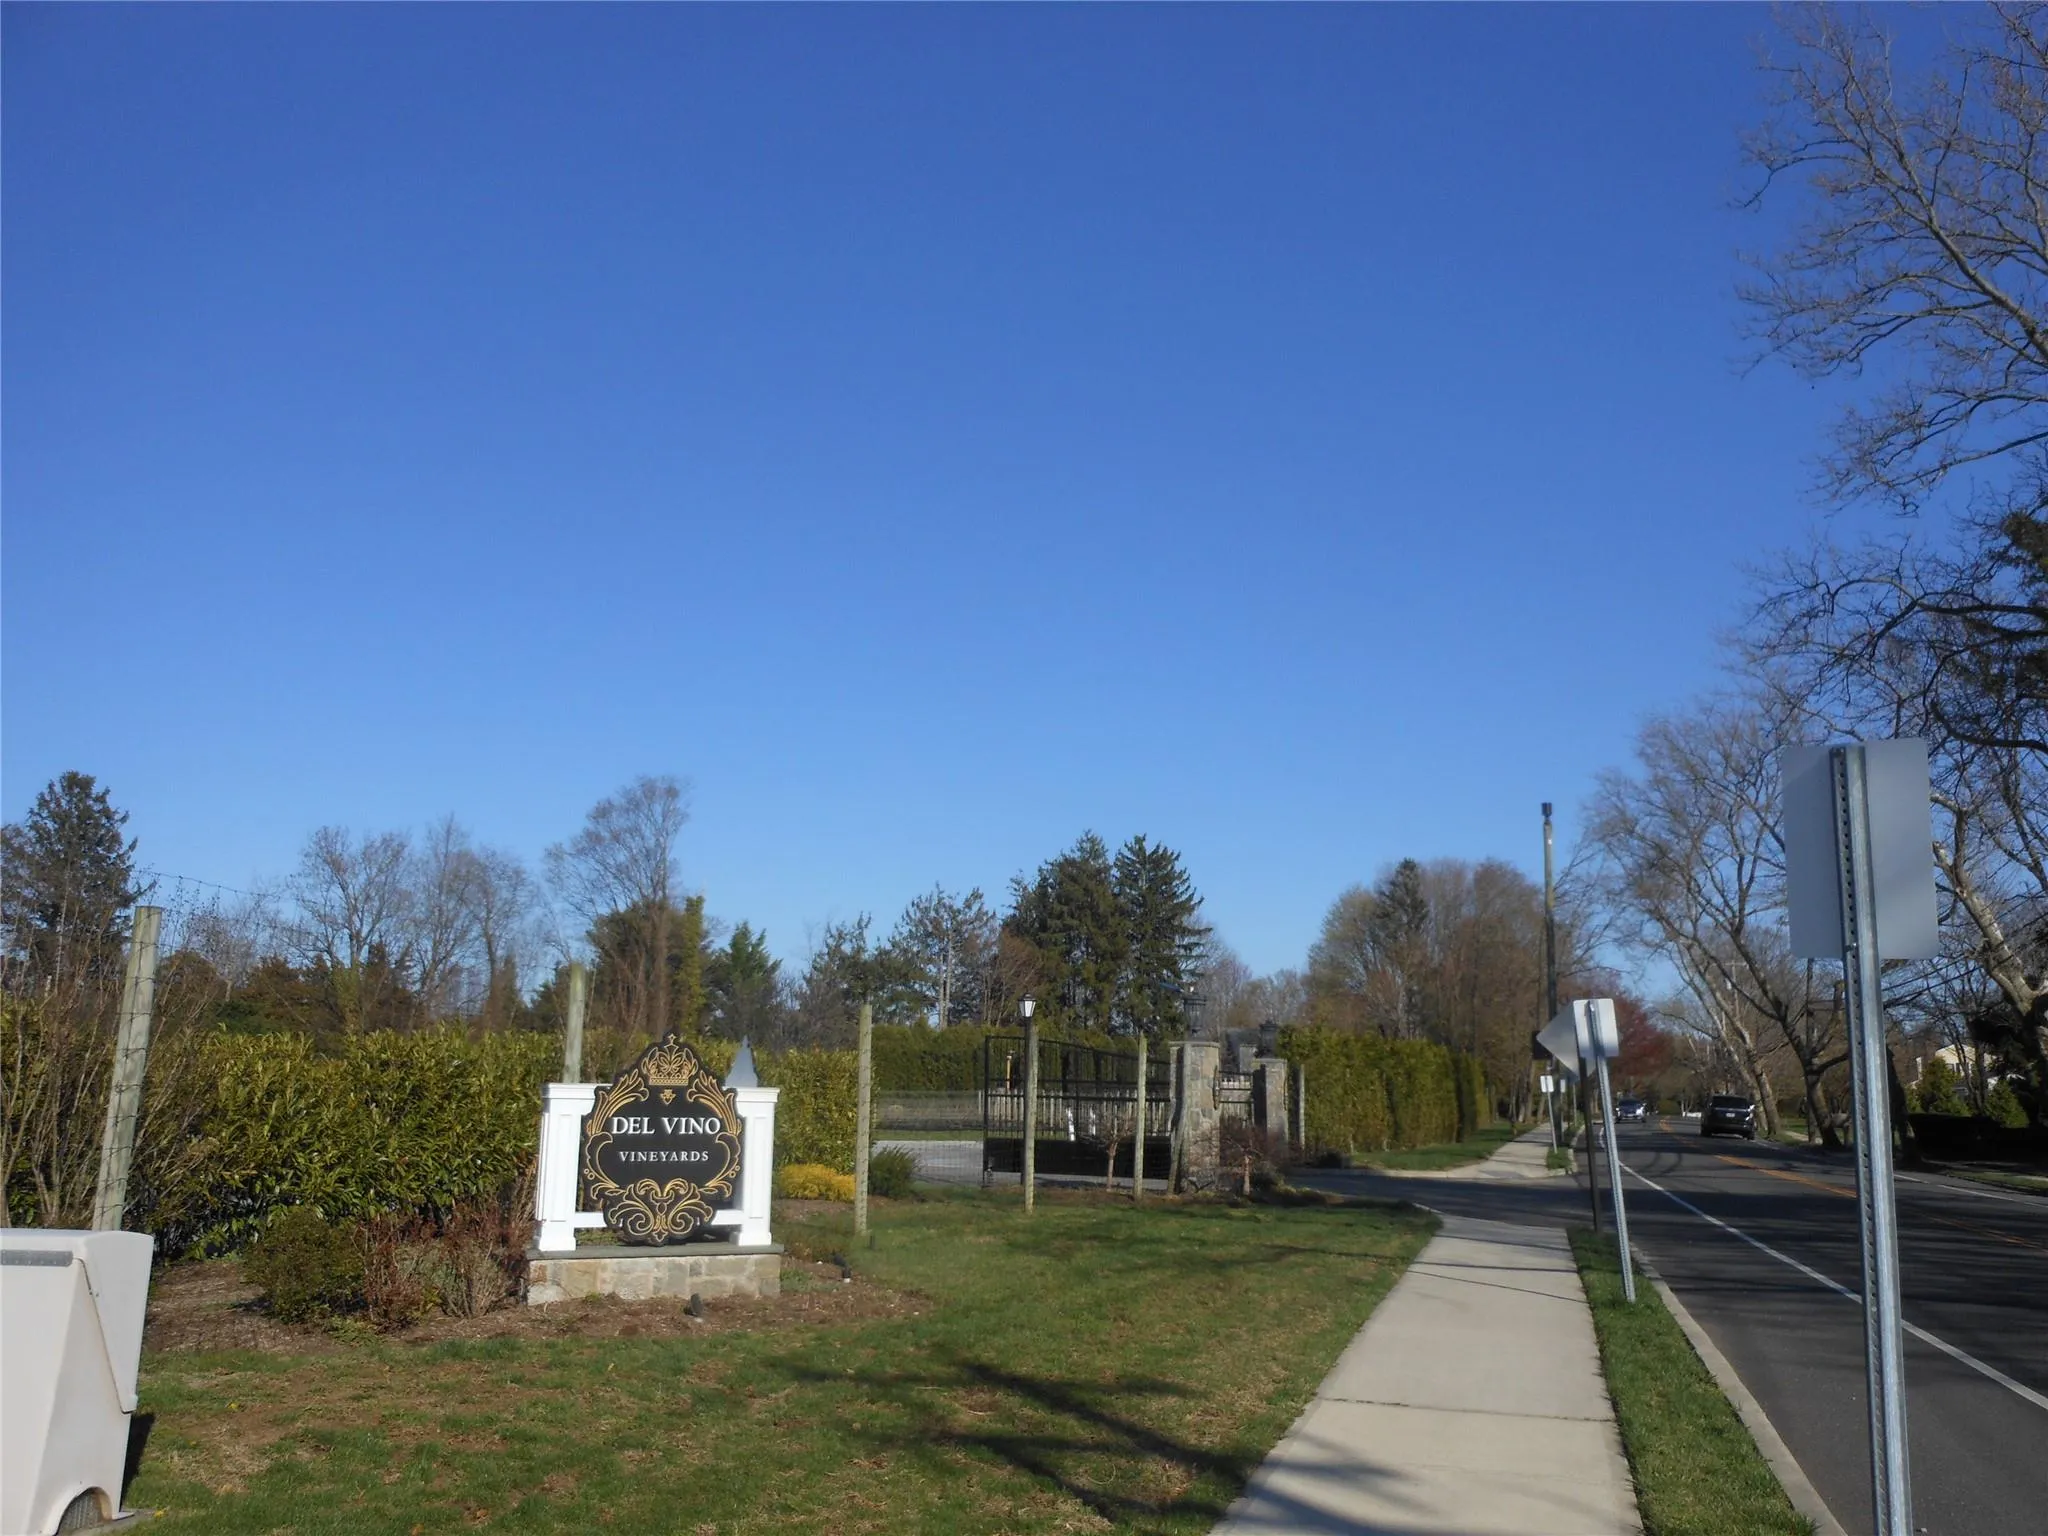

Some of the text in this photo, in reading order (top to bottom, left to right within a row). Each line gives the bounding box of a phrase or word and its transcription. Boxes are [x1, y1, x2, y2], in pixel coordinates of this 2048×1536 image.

[611, 1116, 721, 1135] DEL VINO
[619, 1151, 709, 1162] VINEYARDS
